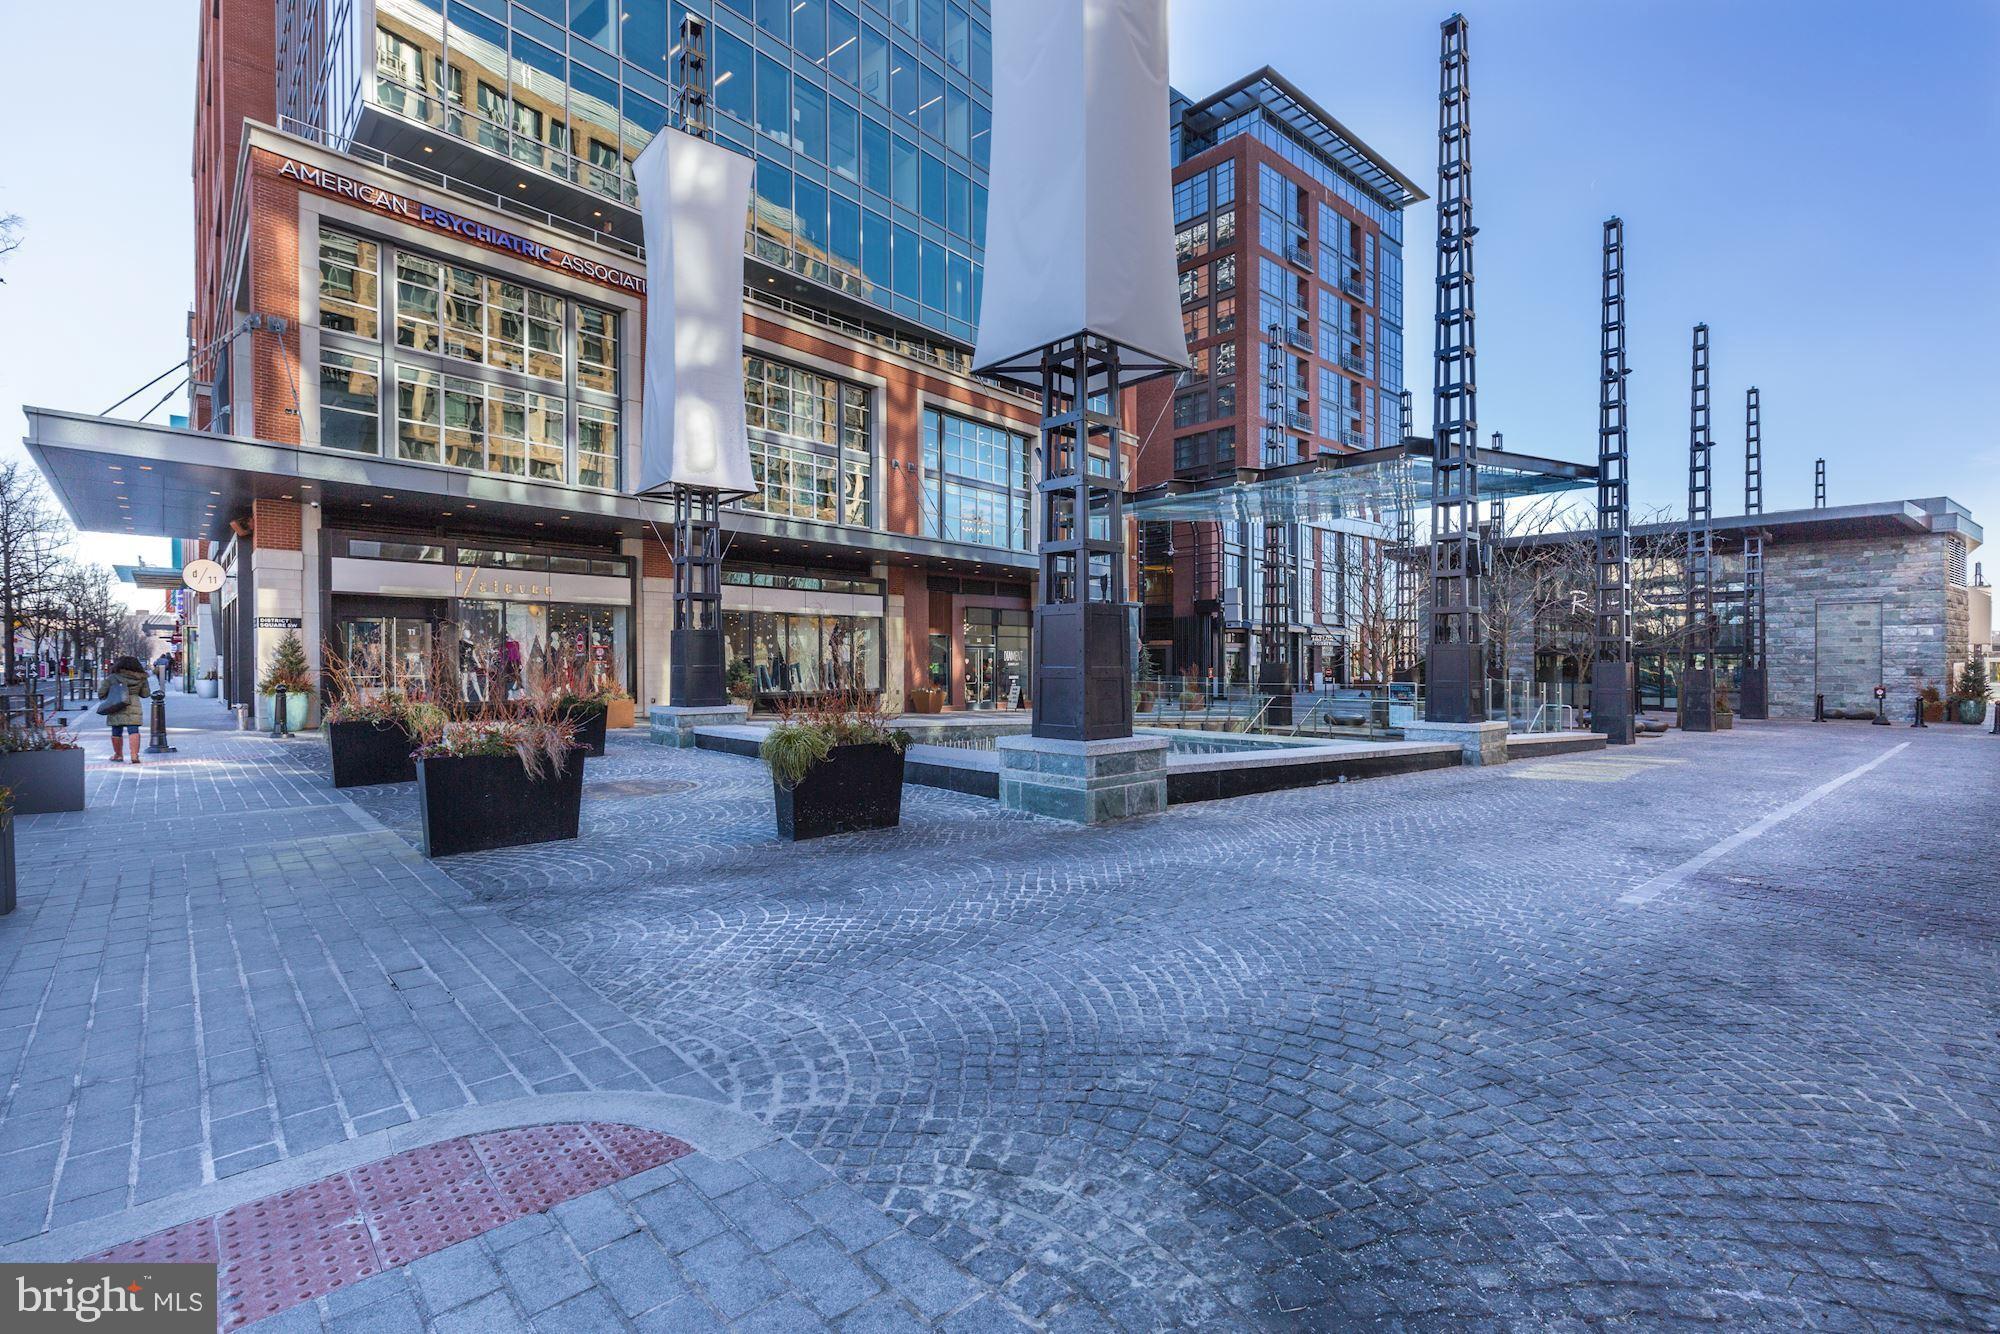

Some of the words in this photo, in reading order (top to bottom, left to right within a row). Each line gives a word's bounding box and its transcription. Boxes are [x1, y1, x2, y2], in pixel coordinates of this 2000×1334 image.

[279, 159, 408, 215] AMERICAN
[420, 203, 552, 262] PSYCHIATRIC
[560, 254, 646, 293] ASSOCIATI
